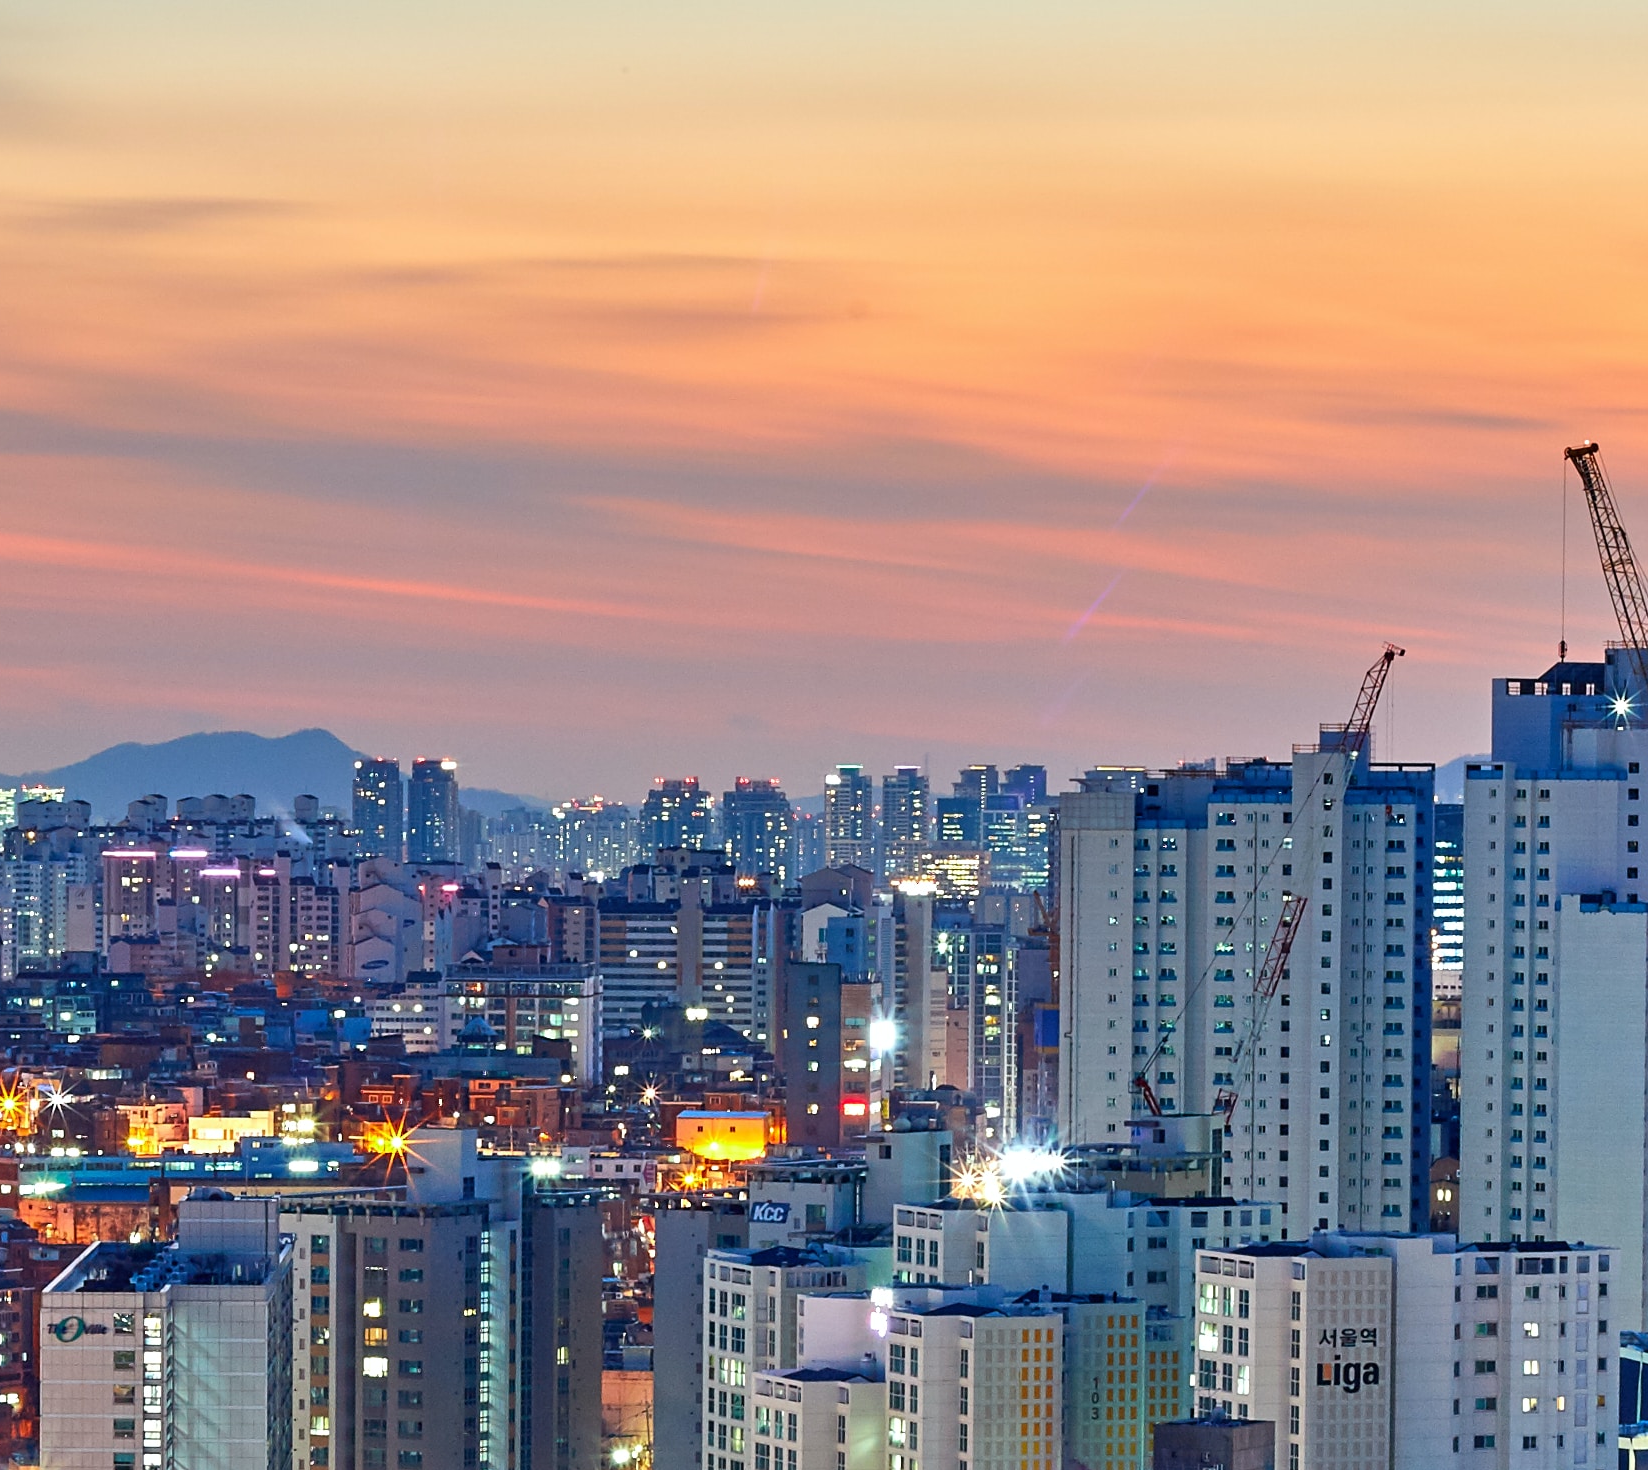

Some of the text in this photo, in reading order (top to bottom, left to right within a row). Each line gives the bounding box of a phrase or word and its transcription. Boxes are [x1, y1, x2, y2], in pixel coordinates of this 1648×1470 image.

[753, 1203, 784, 1221] KCC
[1318, 1328, 1377, 1348] 서울역
[1317, 1354, 1379, 1394] Liga
[1091, 1377, 1100, 1420] 103
